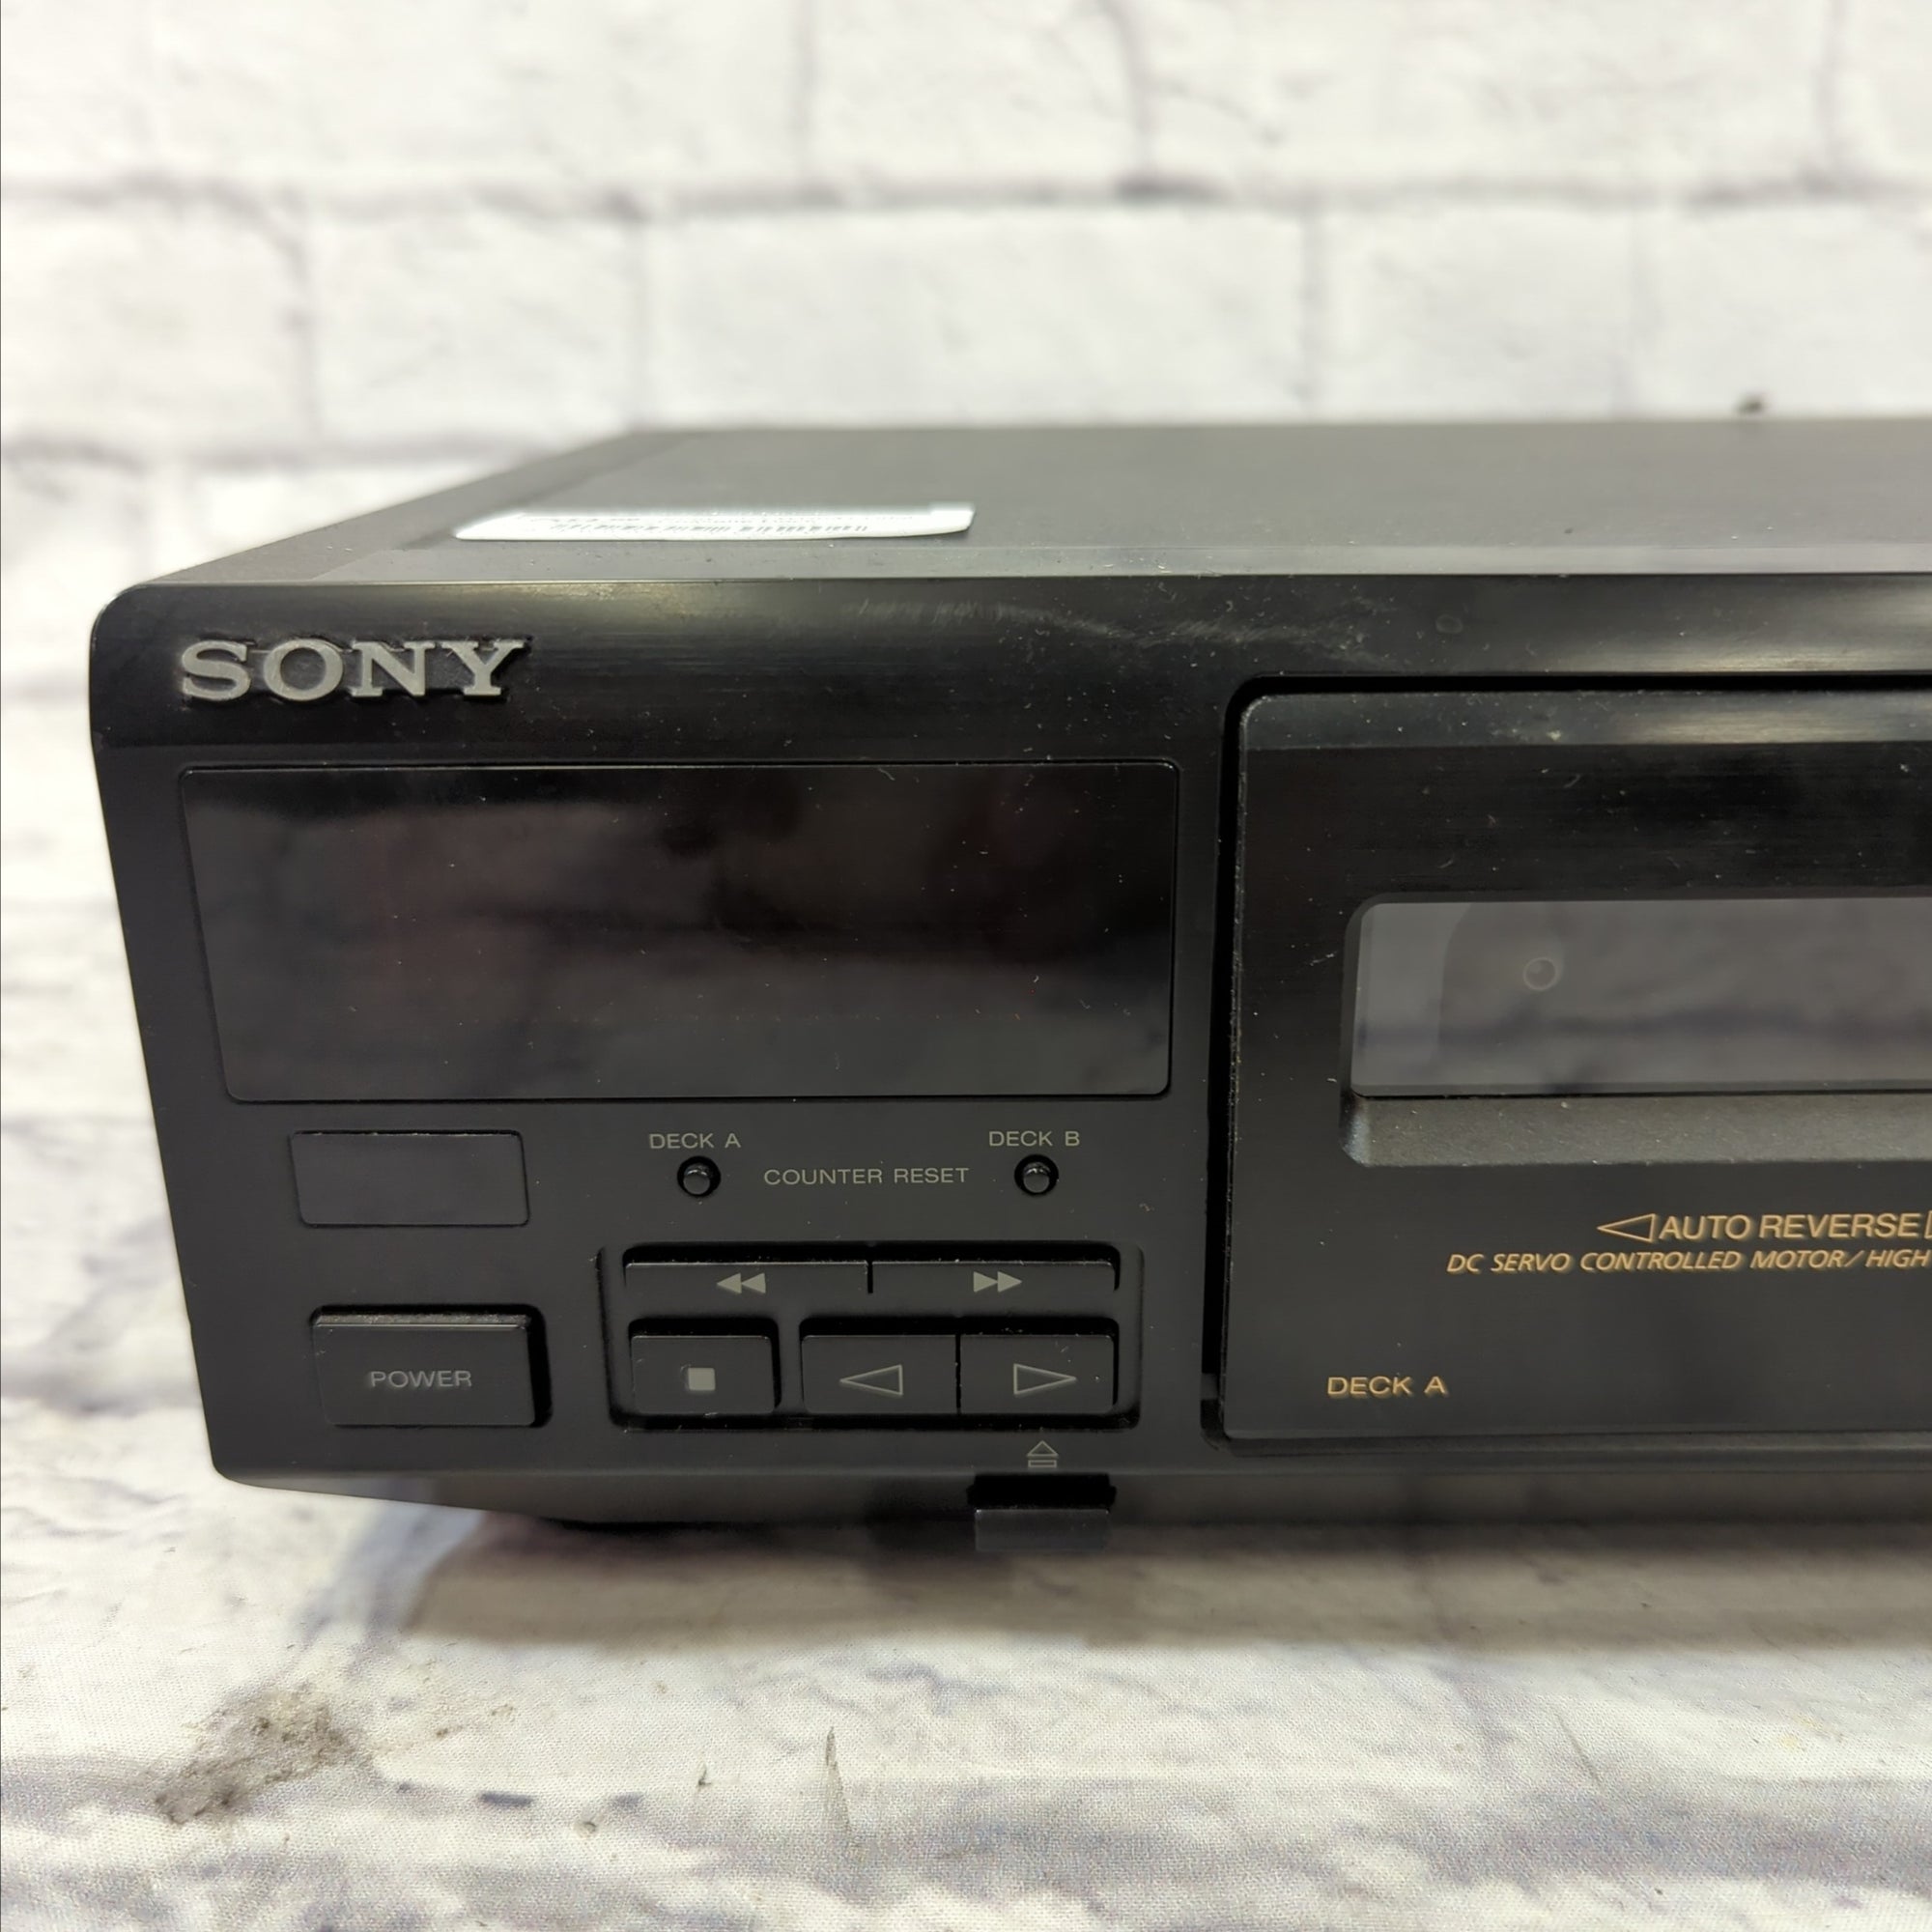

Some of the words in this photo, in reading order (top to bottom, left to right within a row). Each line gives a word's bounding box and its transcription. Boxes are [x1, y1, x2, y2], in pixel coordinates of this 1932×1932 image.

[181, 638, 526, 703] SONY
[648, 1132, 715, 1150] DECK
[724, 1132, 742, 1149] A
[988, 1130, 1053, 1148] DECK
[1065, 1130, 1080, 1147] B
[763, 1168, 883, 1185] COUNTER
[894, 1167, 969, 1184] RESET
[1659, 1214, 1751, 1240] AUTO
[1758, 1212, 1921, 1238] REVERSE
[1446, 1253, 1485, 1272] DC
[1491, 1252, 1572, 1271] SERVO
[1579, 1250, 1742, 1271] CONTROLLED
[369, 1370, 472, 1388] POWER
[1326, 1375, 1412, 1396] DECK
[1423, 1375, 1447, 1394] A
